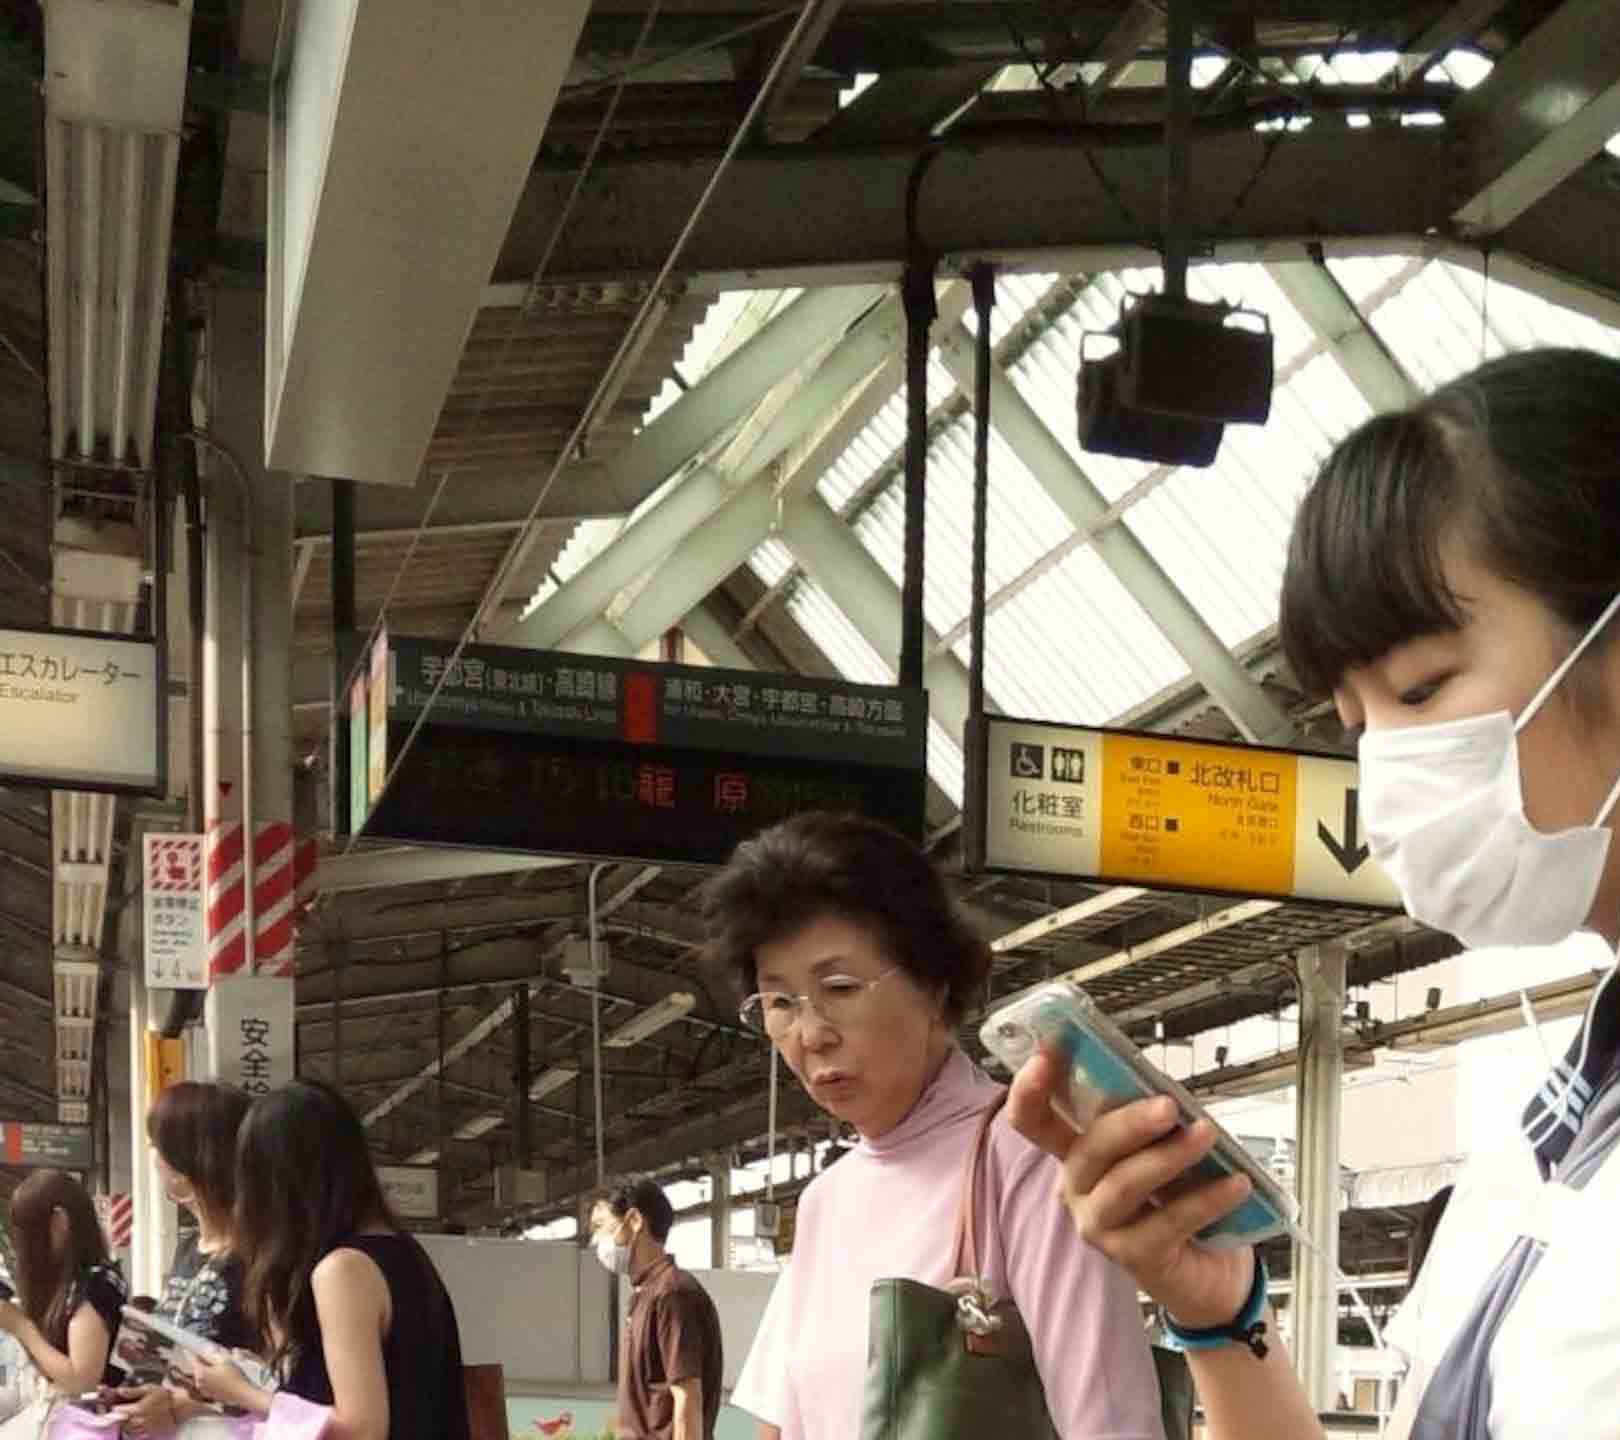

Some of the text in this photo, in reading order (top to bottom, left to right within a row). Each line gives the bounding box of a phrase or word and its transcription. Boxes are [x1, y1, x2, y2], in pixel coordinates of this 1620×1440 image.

[0, 652, 141, 685] エスカレーター
[1190, 760, 1280, 794] 北改札口
[1012, 789, 1083, 818] 化粧室
[1009, 817, 1083, 838] Restrooms
